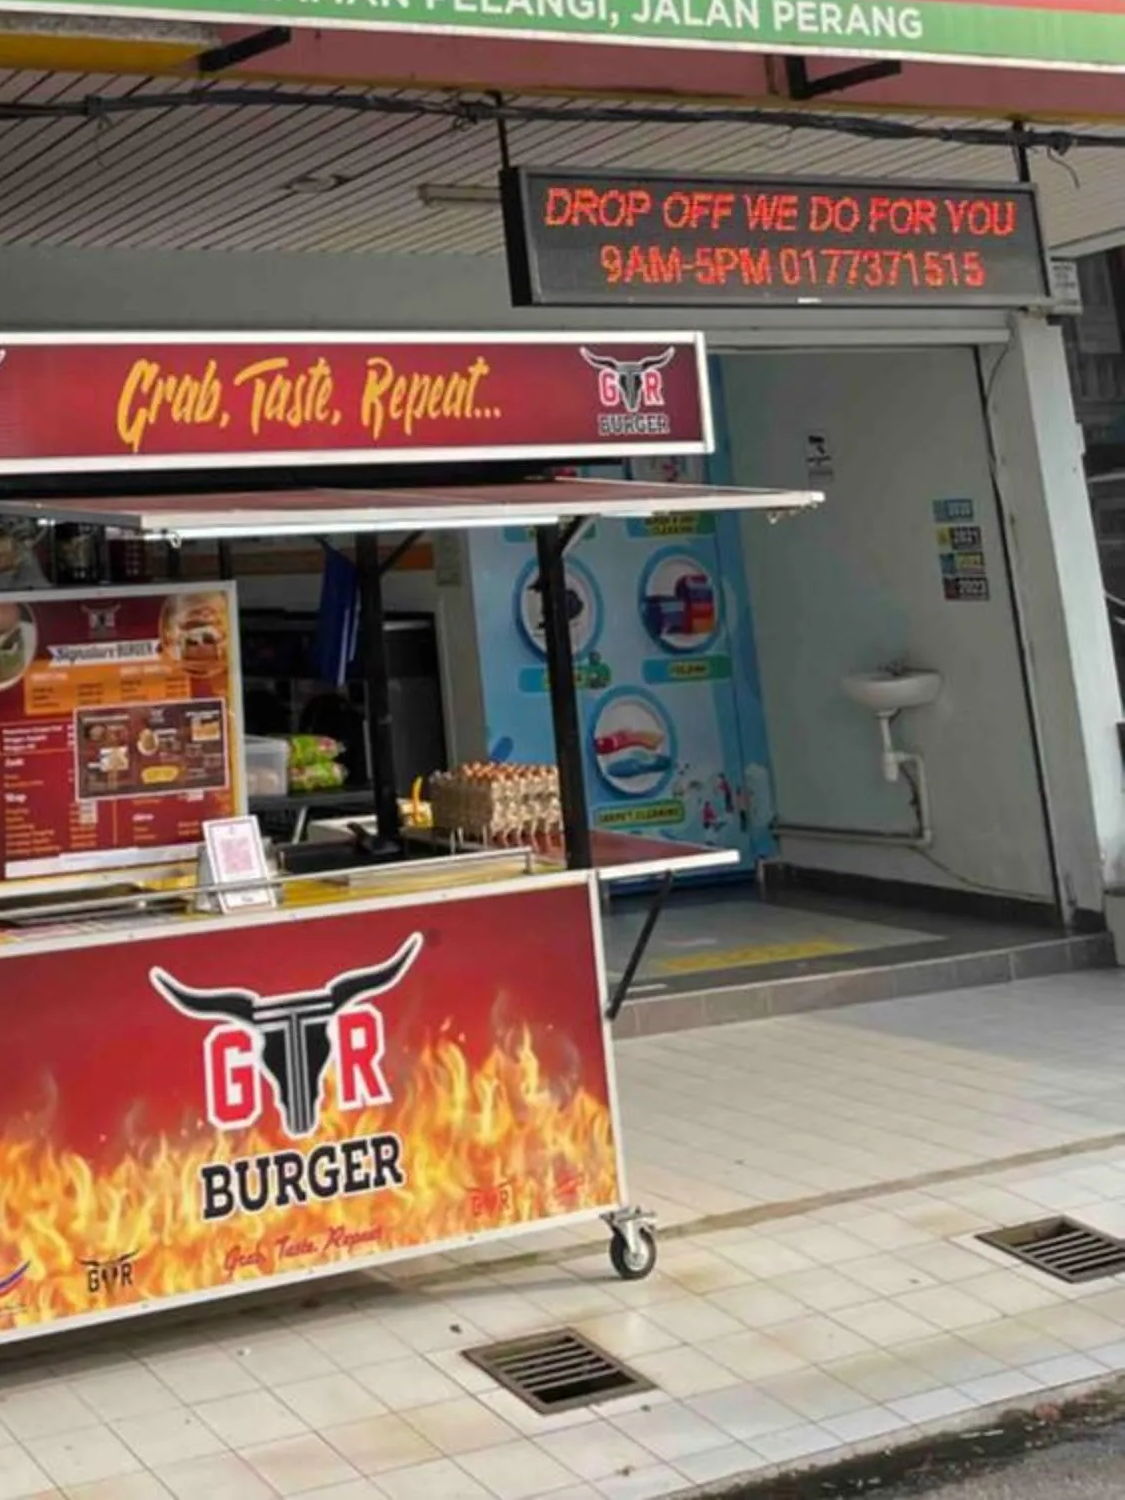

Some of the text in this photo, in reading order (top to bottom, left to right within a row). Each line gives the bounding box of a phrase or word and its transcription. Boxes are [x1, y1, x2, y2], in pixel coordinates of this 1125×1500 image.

[544, 186, 1017, 237] DROP OFF WE DO FOR YOU
[601, 244, 985, 288] 9AM-5PM 0177371515
[597, 412, 671, 436] BURGER
[200, 1133, 404, 1221] BURGER
